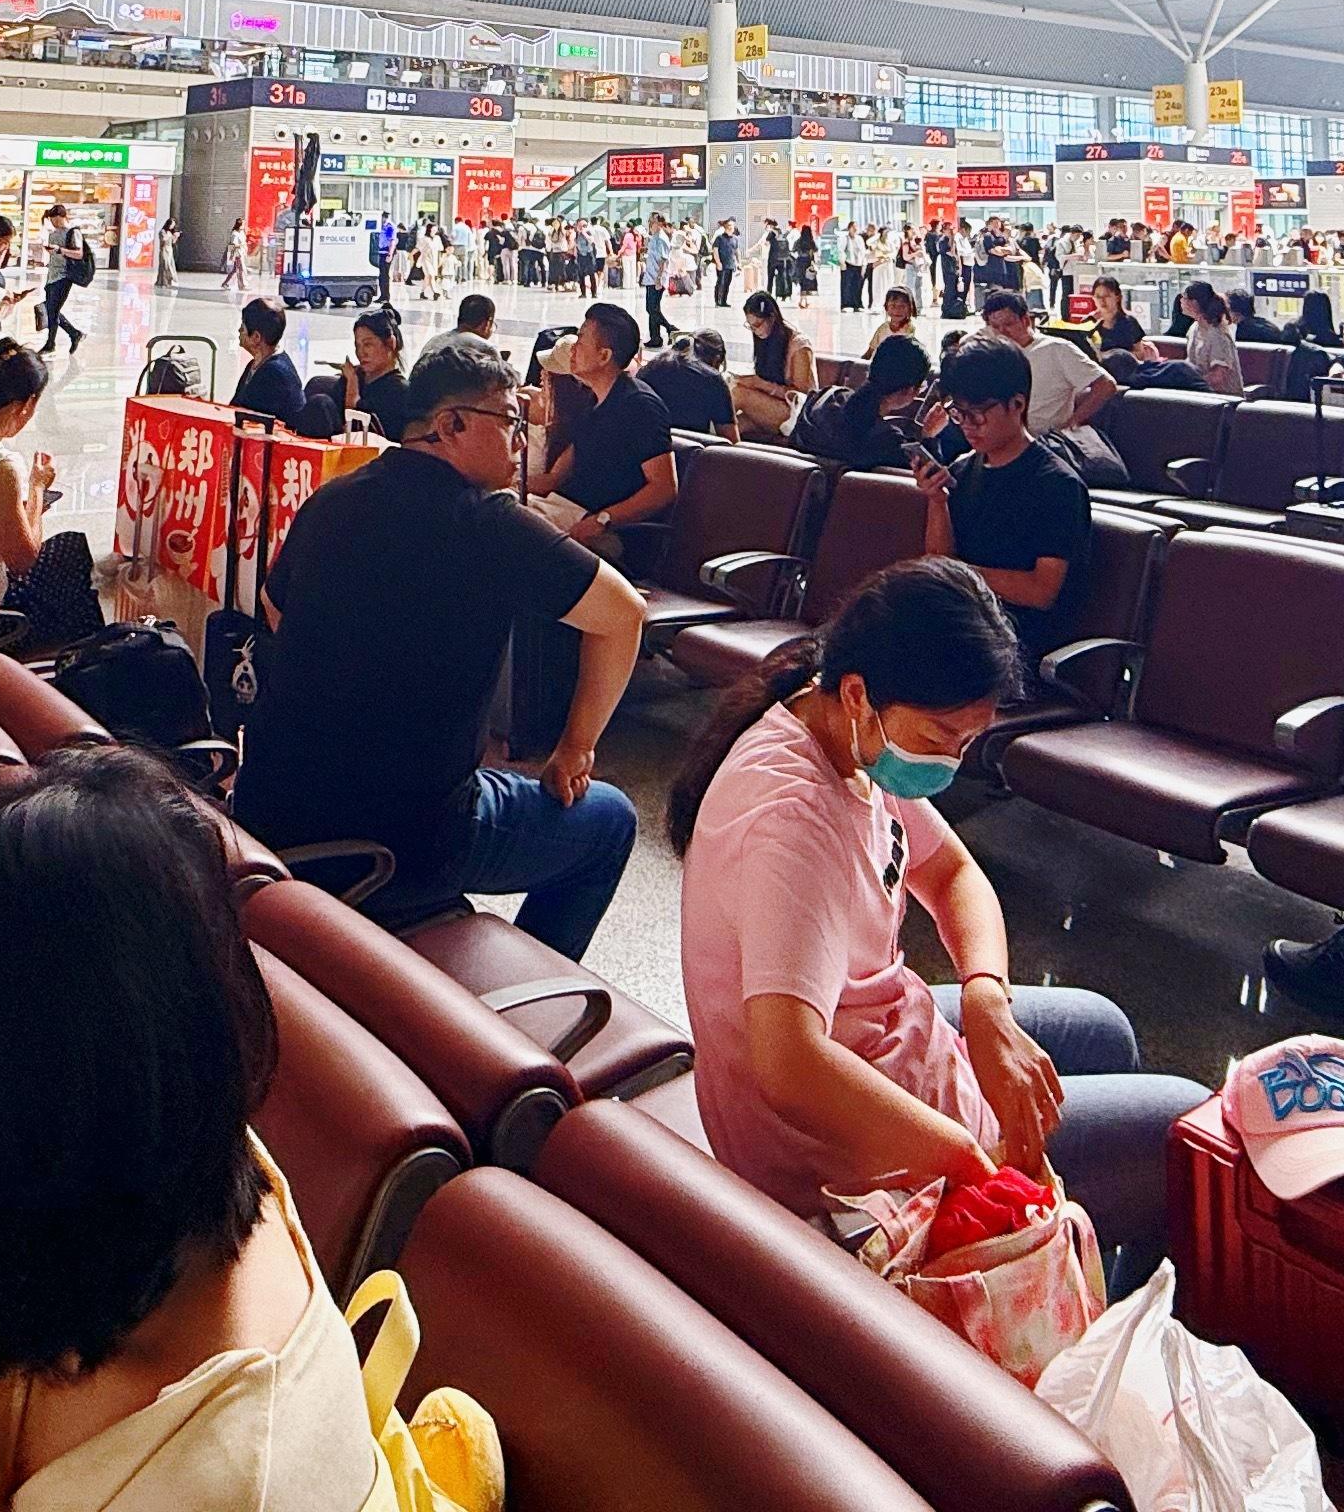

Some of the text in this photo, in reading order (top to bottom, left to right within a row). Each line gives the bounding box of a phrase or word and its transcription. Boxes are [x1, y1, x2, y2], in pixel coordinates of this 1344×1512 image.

[269, 83, 306, 105] 31B
[469, 97, 503, 117] 30B
[800, 120, 826, 138] 29B
[175, 426, 214, 528] 郑州
